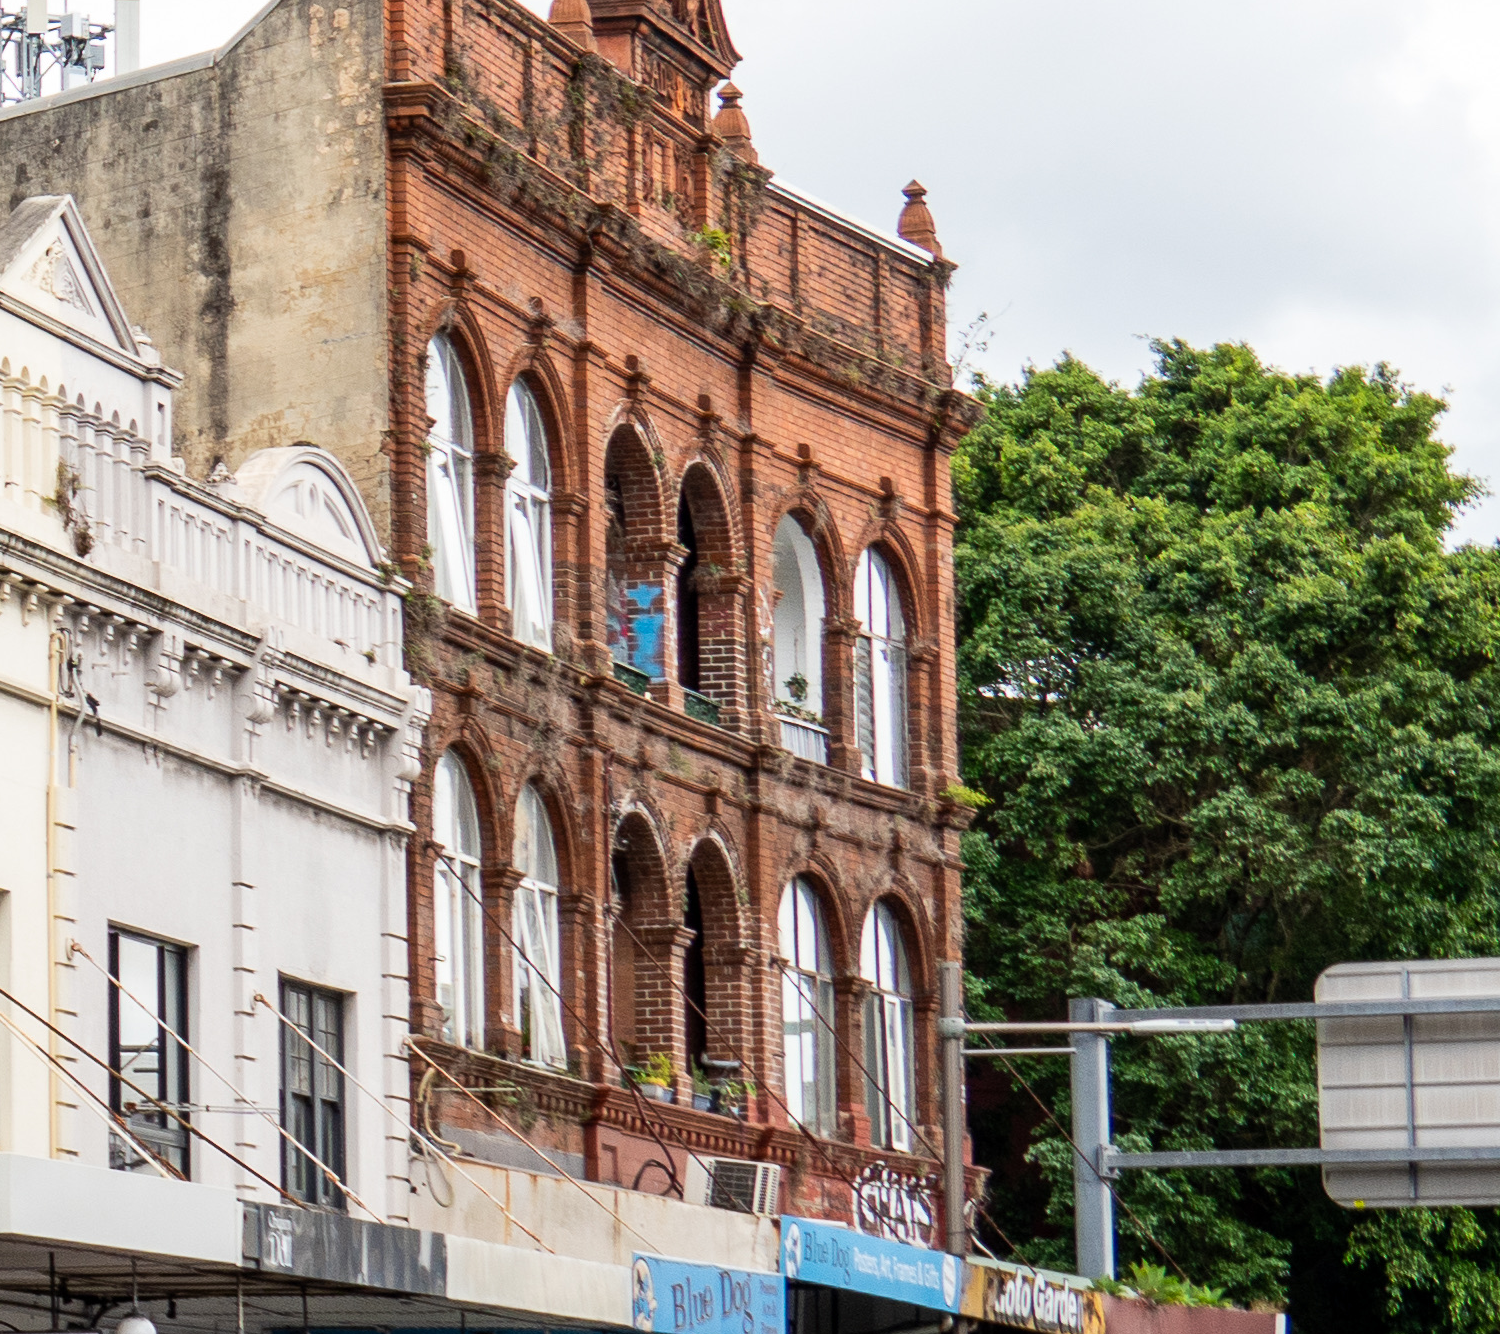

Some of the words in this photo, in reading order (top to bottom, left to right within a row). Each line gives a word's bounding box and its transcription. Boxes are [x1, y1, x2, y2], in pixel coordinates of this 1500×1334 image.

[803, 1231, 829, 1265] Blue
[831, 1237, 851, 1286] Dog
[671, 1275, 714, 1330] Blue
